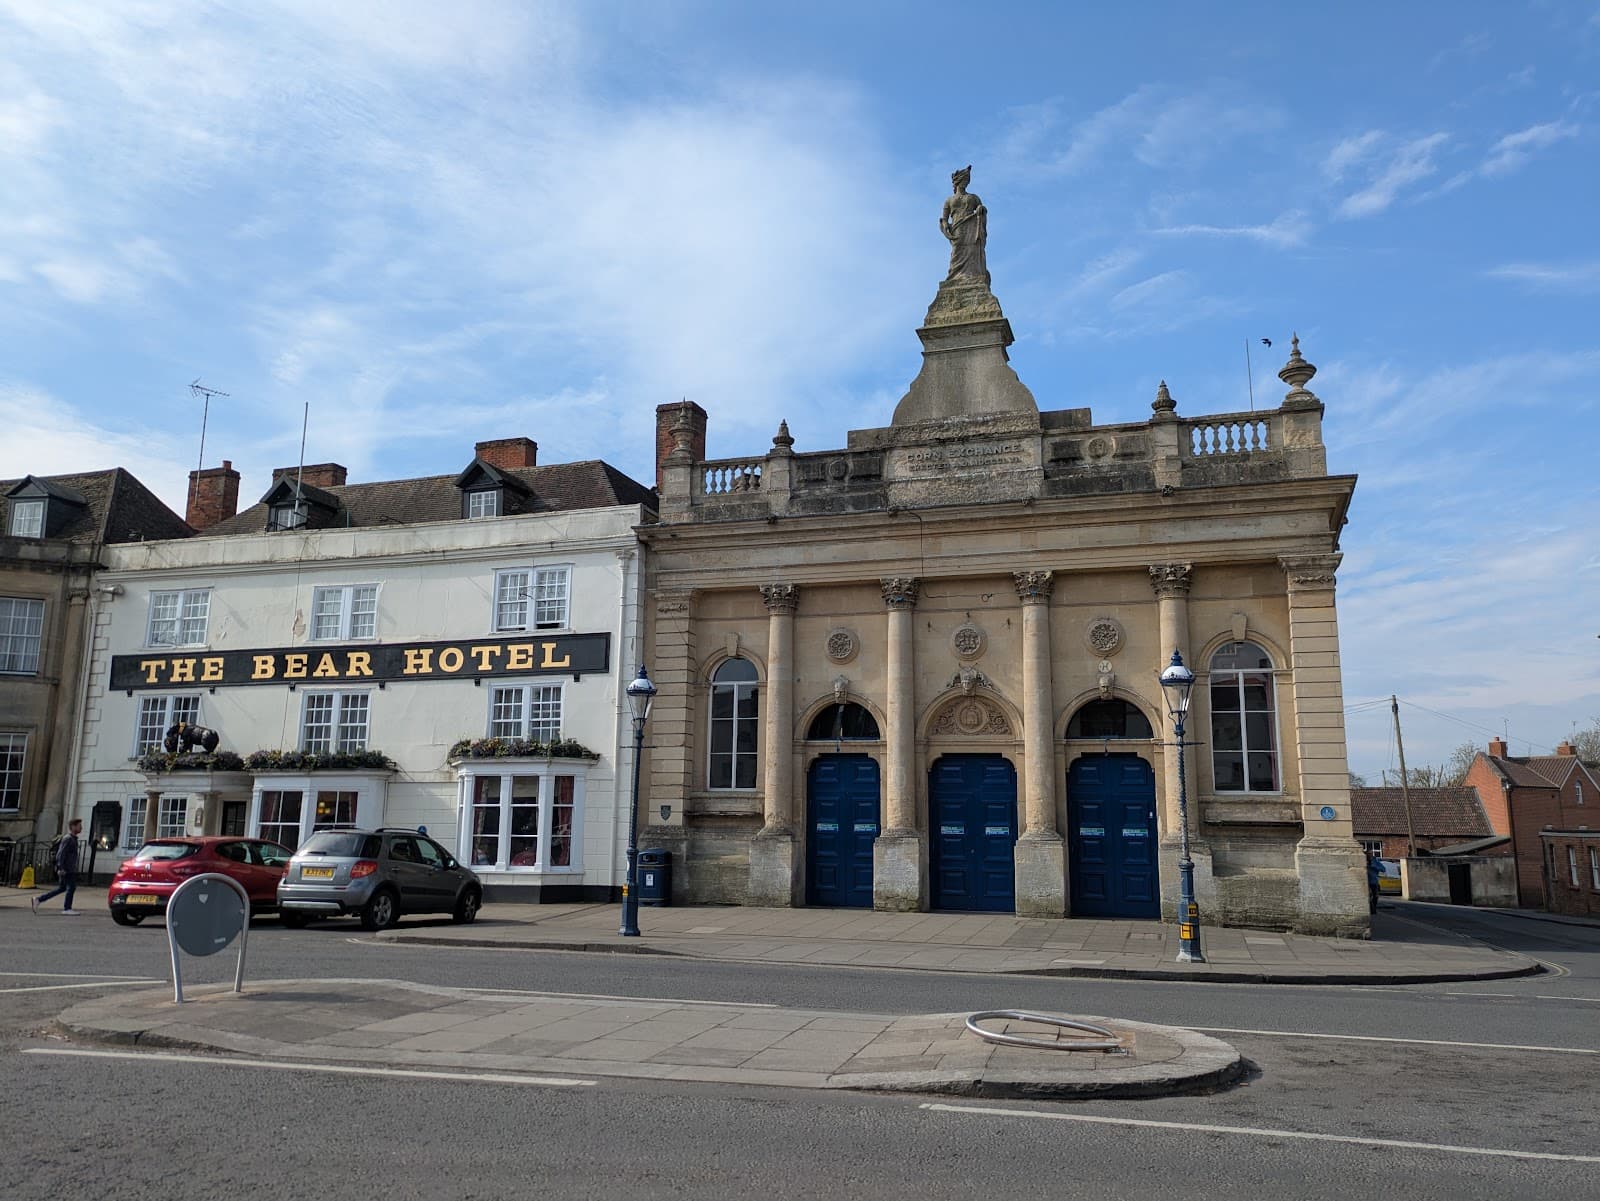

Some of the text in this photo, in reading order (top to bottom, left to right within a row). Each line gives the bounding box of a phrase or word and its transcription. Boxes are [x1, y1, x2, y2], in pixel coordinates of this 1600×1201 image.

[907, 444, 1021, 462] CORN EXCHANGE
[141, 642, 570, 684] THE BEAR HOTEL
